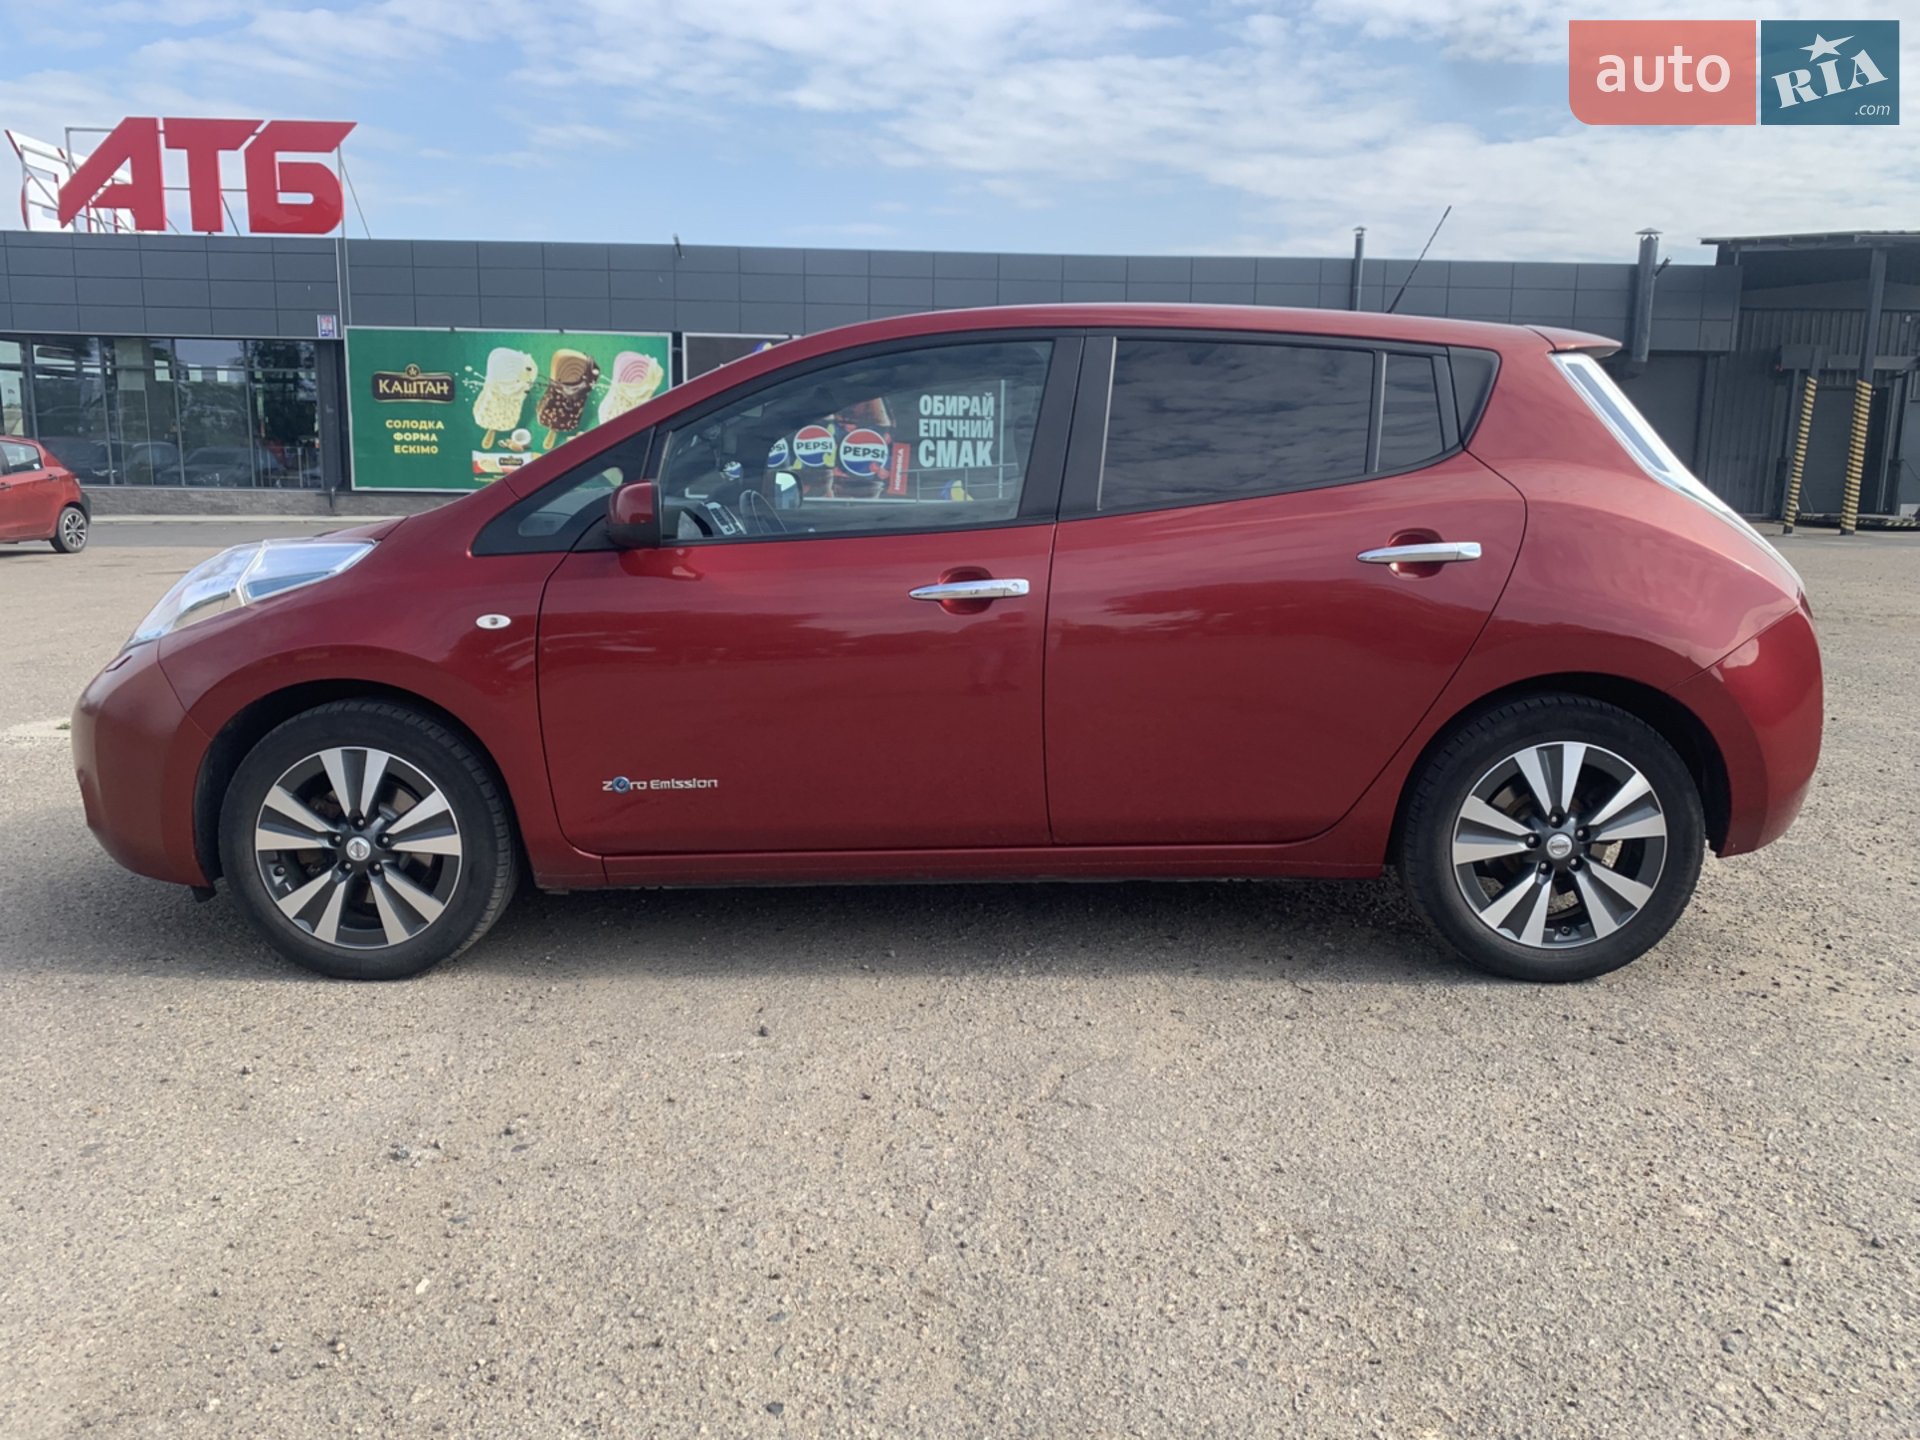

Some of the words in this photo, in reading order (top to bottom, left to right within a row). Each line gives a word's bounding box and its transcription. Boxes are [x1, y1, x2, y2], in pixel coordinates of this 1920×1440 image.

[58, 116, 358, 235] АТБ
[378, 379, 449, 395] КАШТАН
[919, 392, 995, 417] ОБИРАЙ
[385, 419, 445, 430] СОЛОДКА
[919, 416, 994, 438] ЕПІЧНИЙ
[393, 432, 438, 442] ФОРМА
[394, 444, 439, 455] ЕСКІМО
[796, 441, 833, 451] PEPSI
[843, 445, 886, 460] PEPSI
[918, 439, 994, 468] СМАК
[650, 778, 718, 790] Emission
